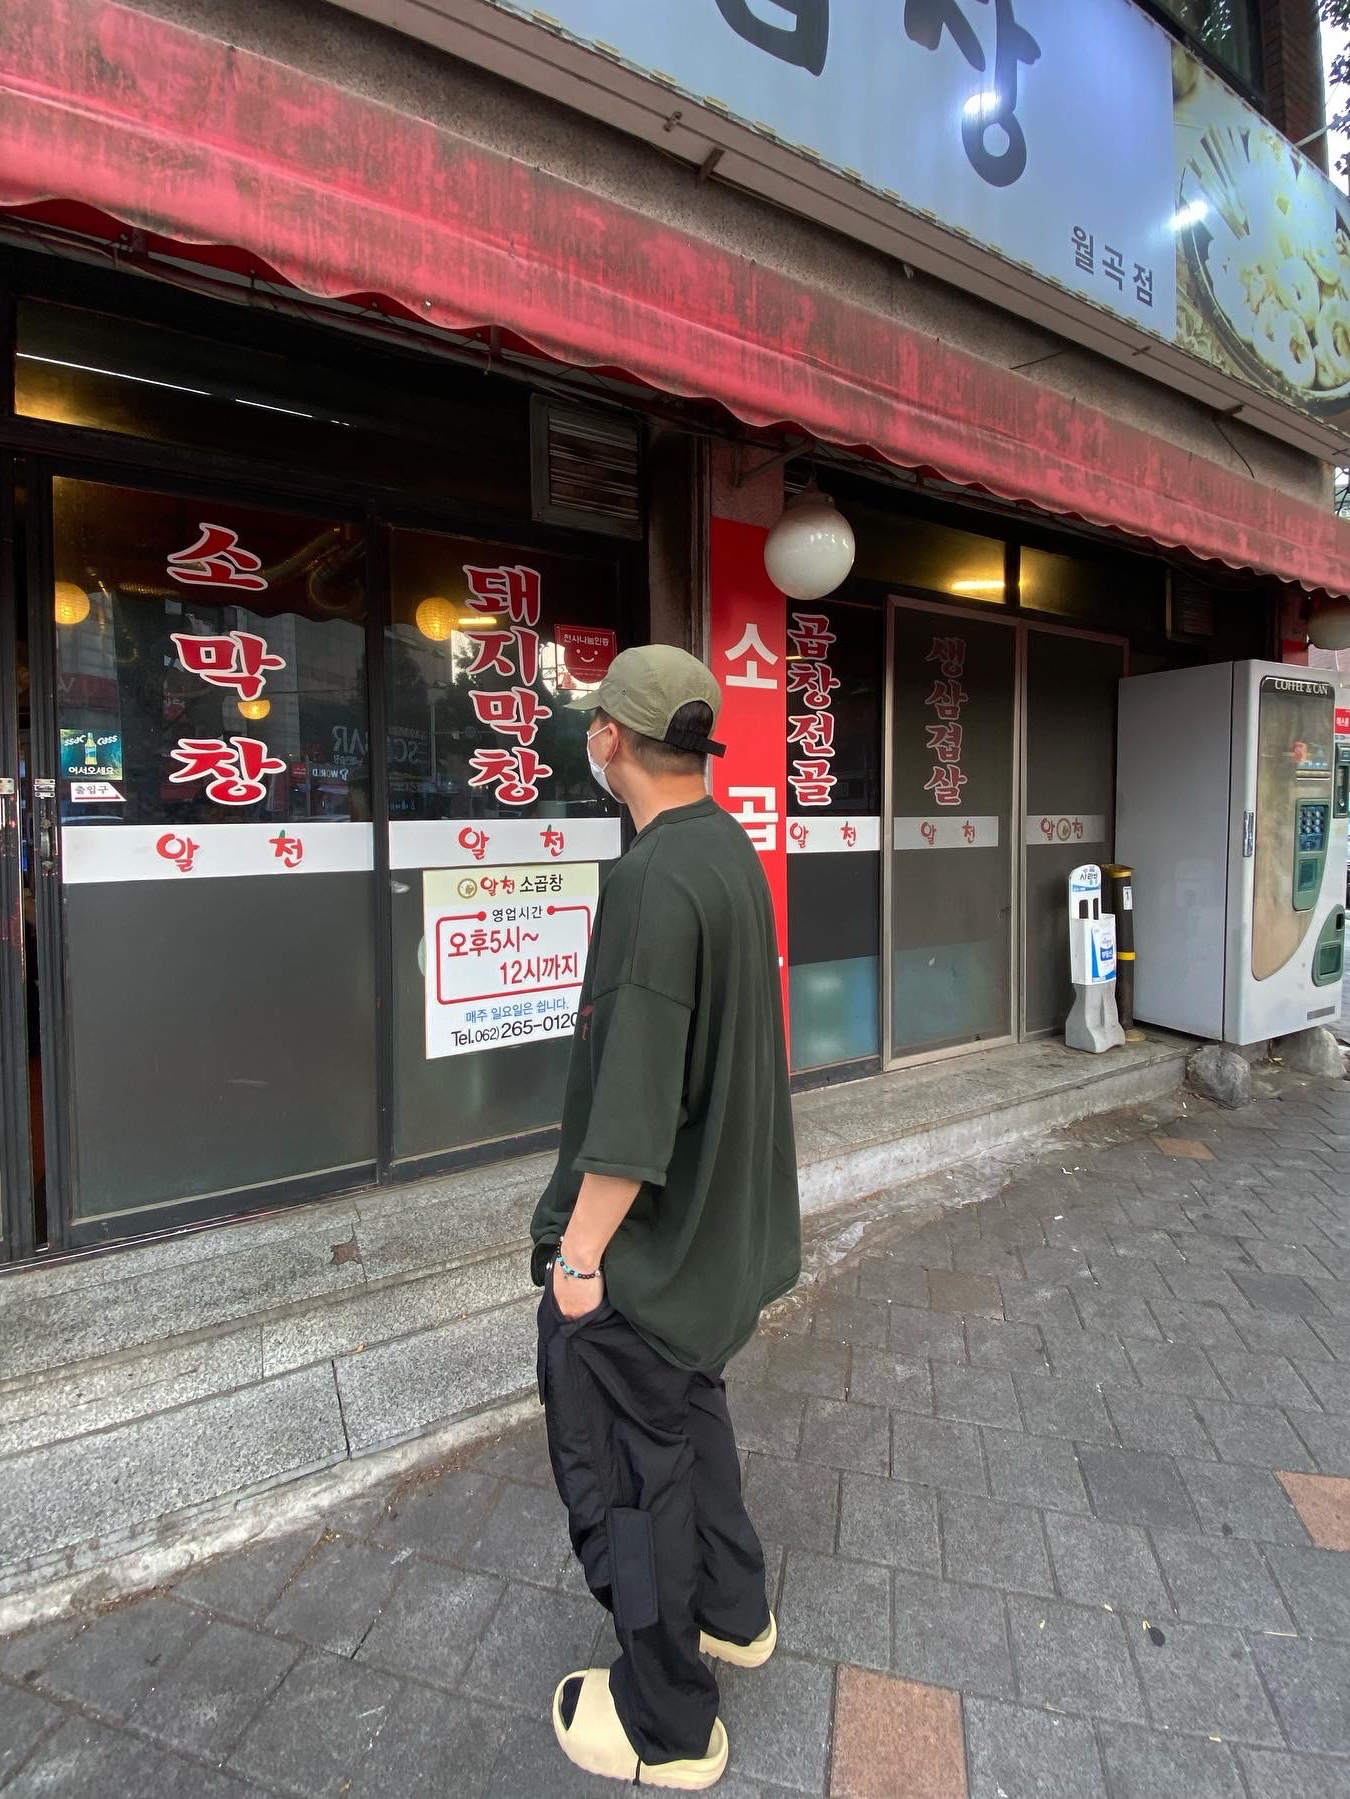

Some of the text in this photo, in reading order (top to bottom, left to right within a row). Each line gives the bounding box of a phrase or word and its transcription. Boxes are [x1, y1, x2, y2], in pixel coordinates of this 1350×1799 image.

[714, 0, 1042, 188] 창
[1071, 225, 1153, 307] 월곡점
[167, 522, 286, 806] 소막창
[462, 565, 553, 805] 돼지막창
[1274, 680, 1304, 692] COFFEE
[1313, 684, 1328, 695] CAN
[787, 612, 841, 806] 곱창전골
[924, 636, 968, 806] 생삼겹살
[68, 766, 115, 775] 어서오세요
[75, 785, 109, 795] 출입구
[480, 874, 563, 897] 알천 소곱창
[492, 905, 543, 923] 영업시간
[447, 926, 540, 958] 오후5시~
[500, 952, 579, 985] 12시까지
[465, 997, 569, 1024] 매주 일요일은 쉽니다.
